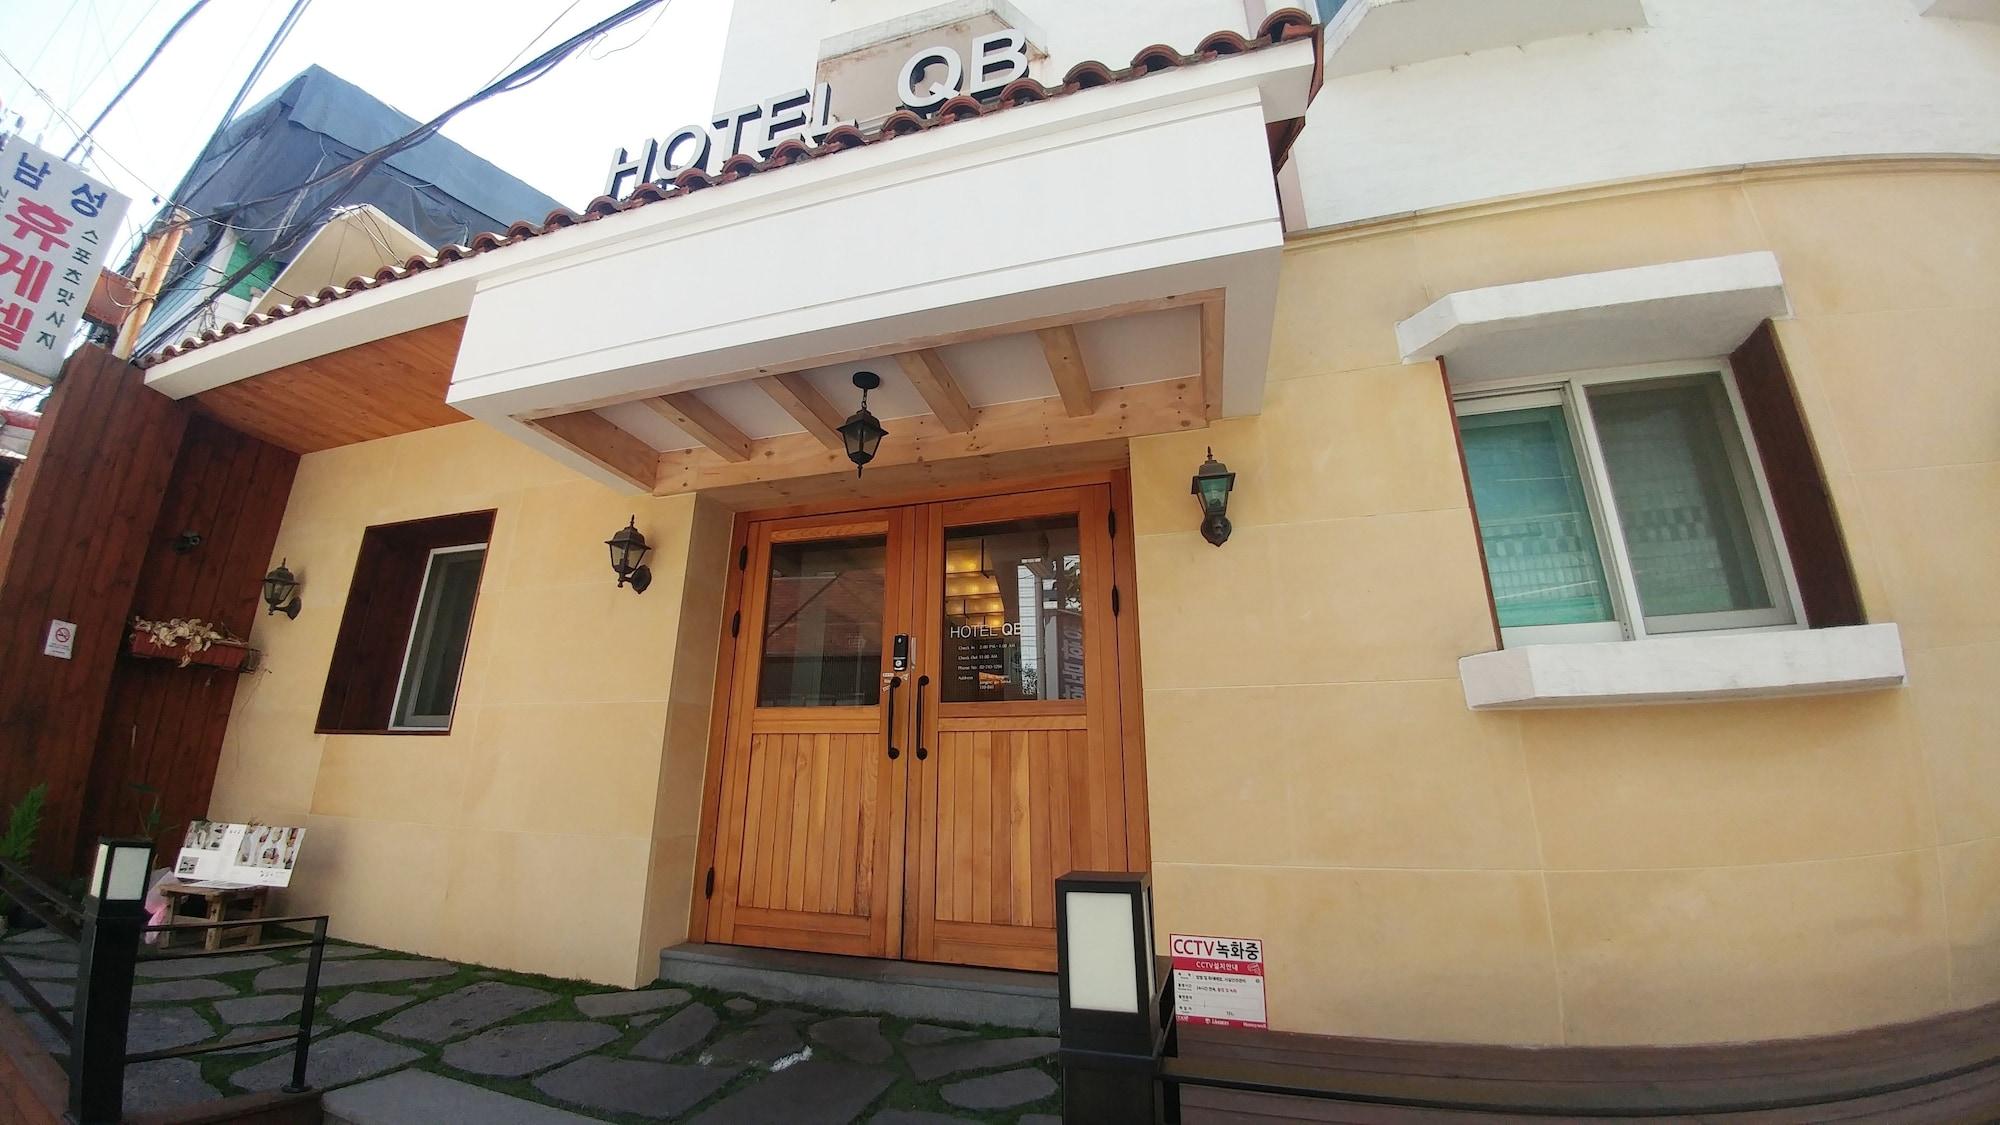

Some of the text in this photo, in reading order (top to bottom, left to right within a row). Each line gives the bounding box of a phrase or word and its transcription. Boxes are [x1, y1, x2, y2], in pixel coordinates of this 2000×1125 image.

[603, 28, 1031, 198] HOTEL QB
[950, 622, 1022, 639] HOTEL QB
